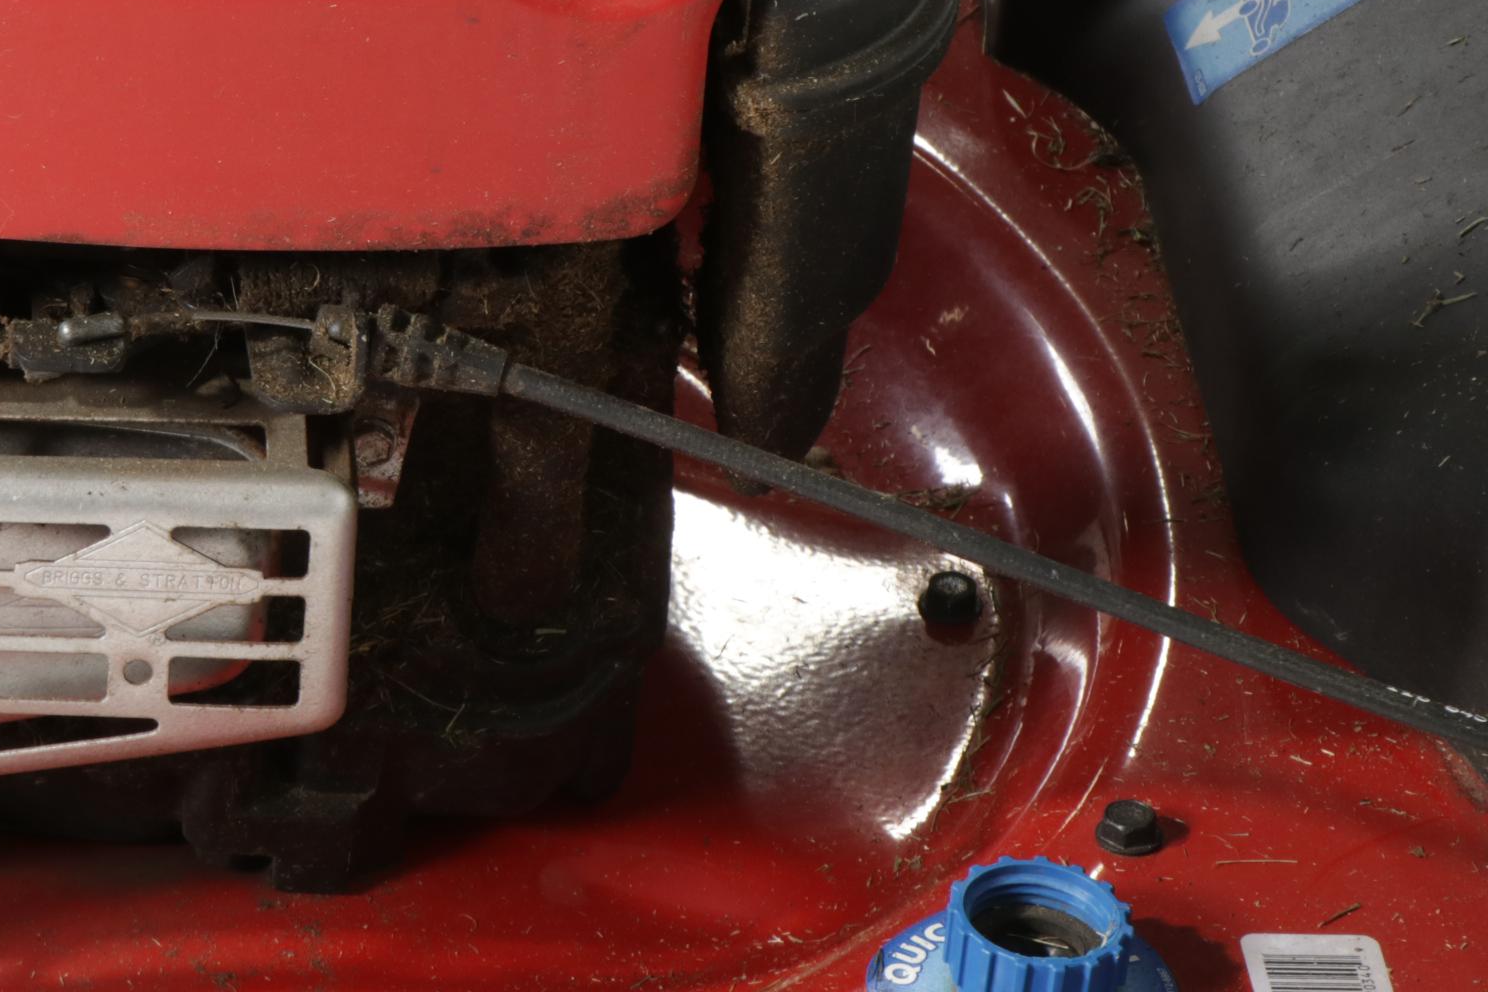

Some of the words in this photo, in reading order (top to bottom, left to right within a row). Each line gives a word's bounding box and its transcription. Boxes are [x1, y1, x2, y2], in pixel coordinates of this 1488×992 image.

[41, 569, 105, 587] BRIGGS
[114, 572, 129, 588] &
[1357, 965, 1378, 992] 0340
